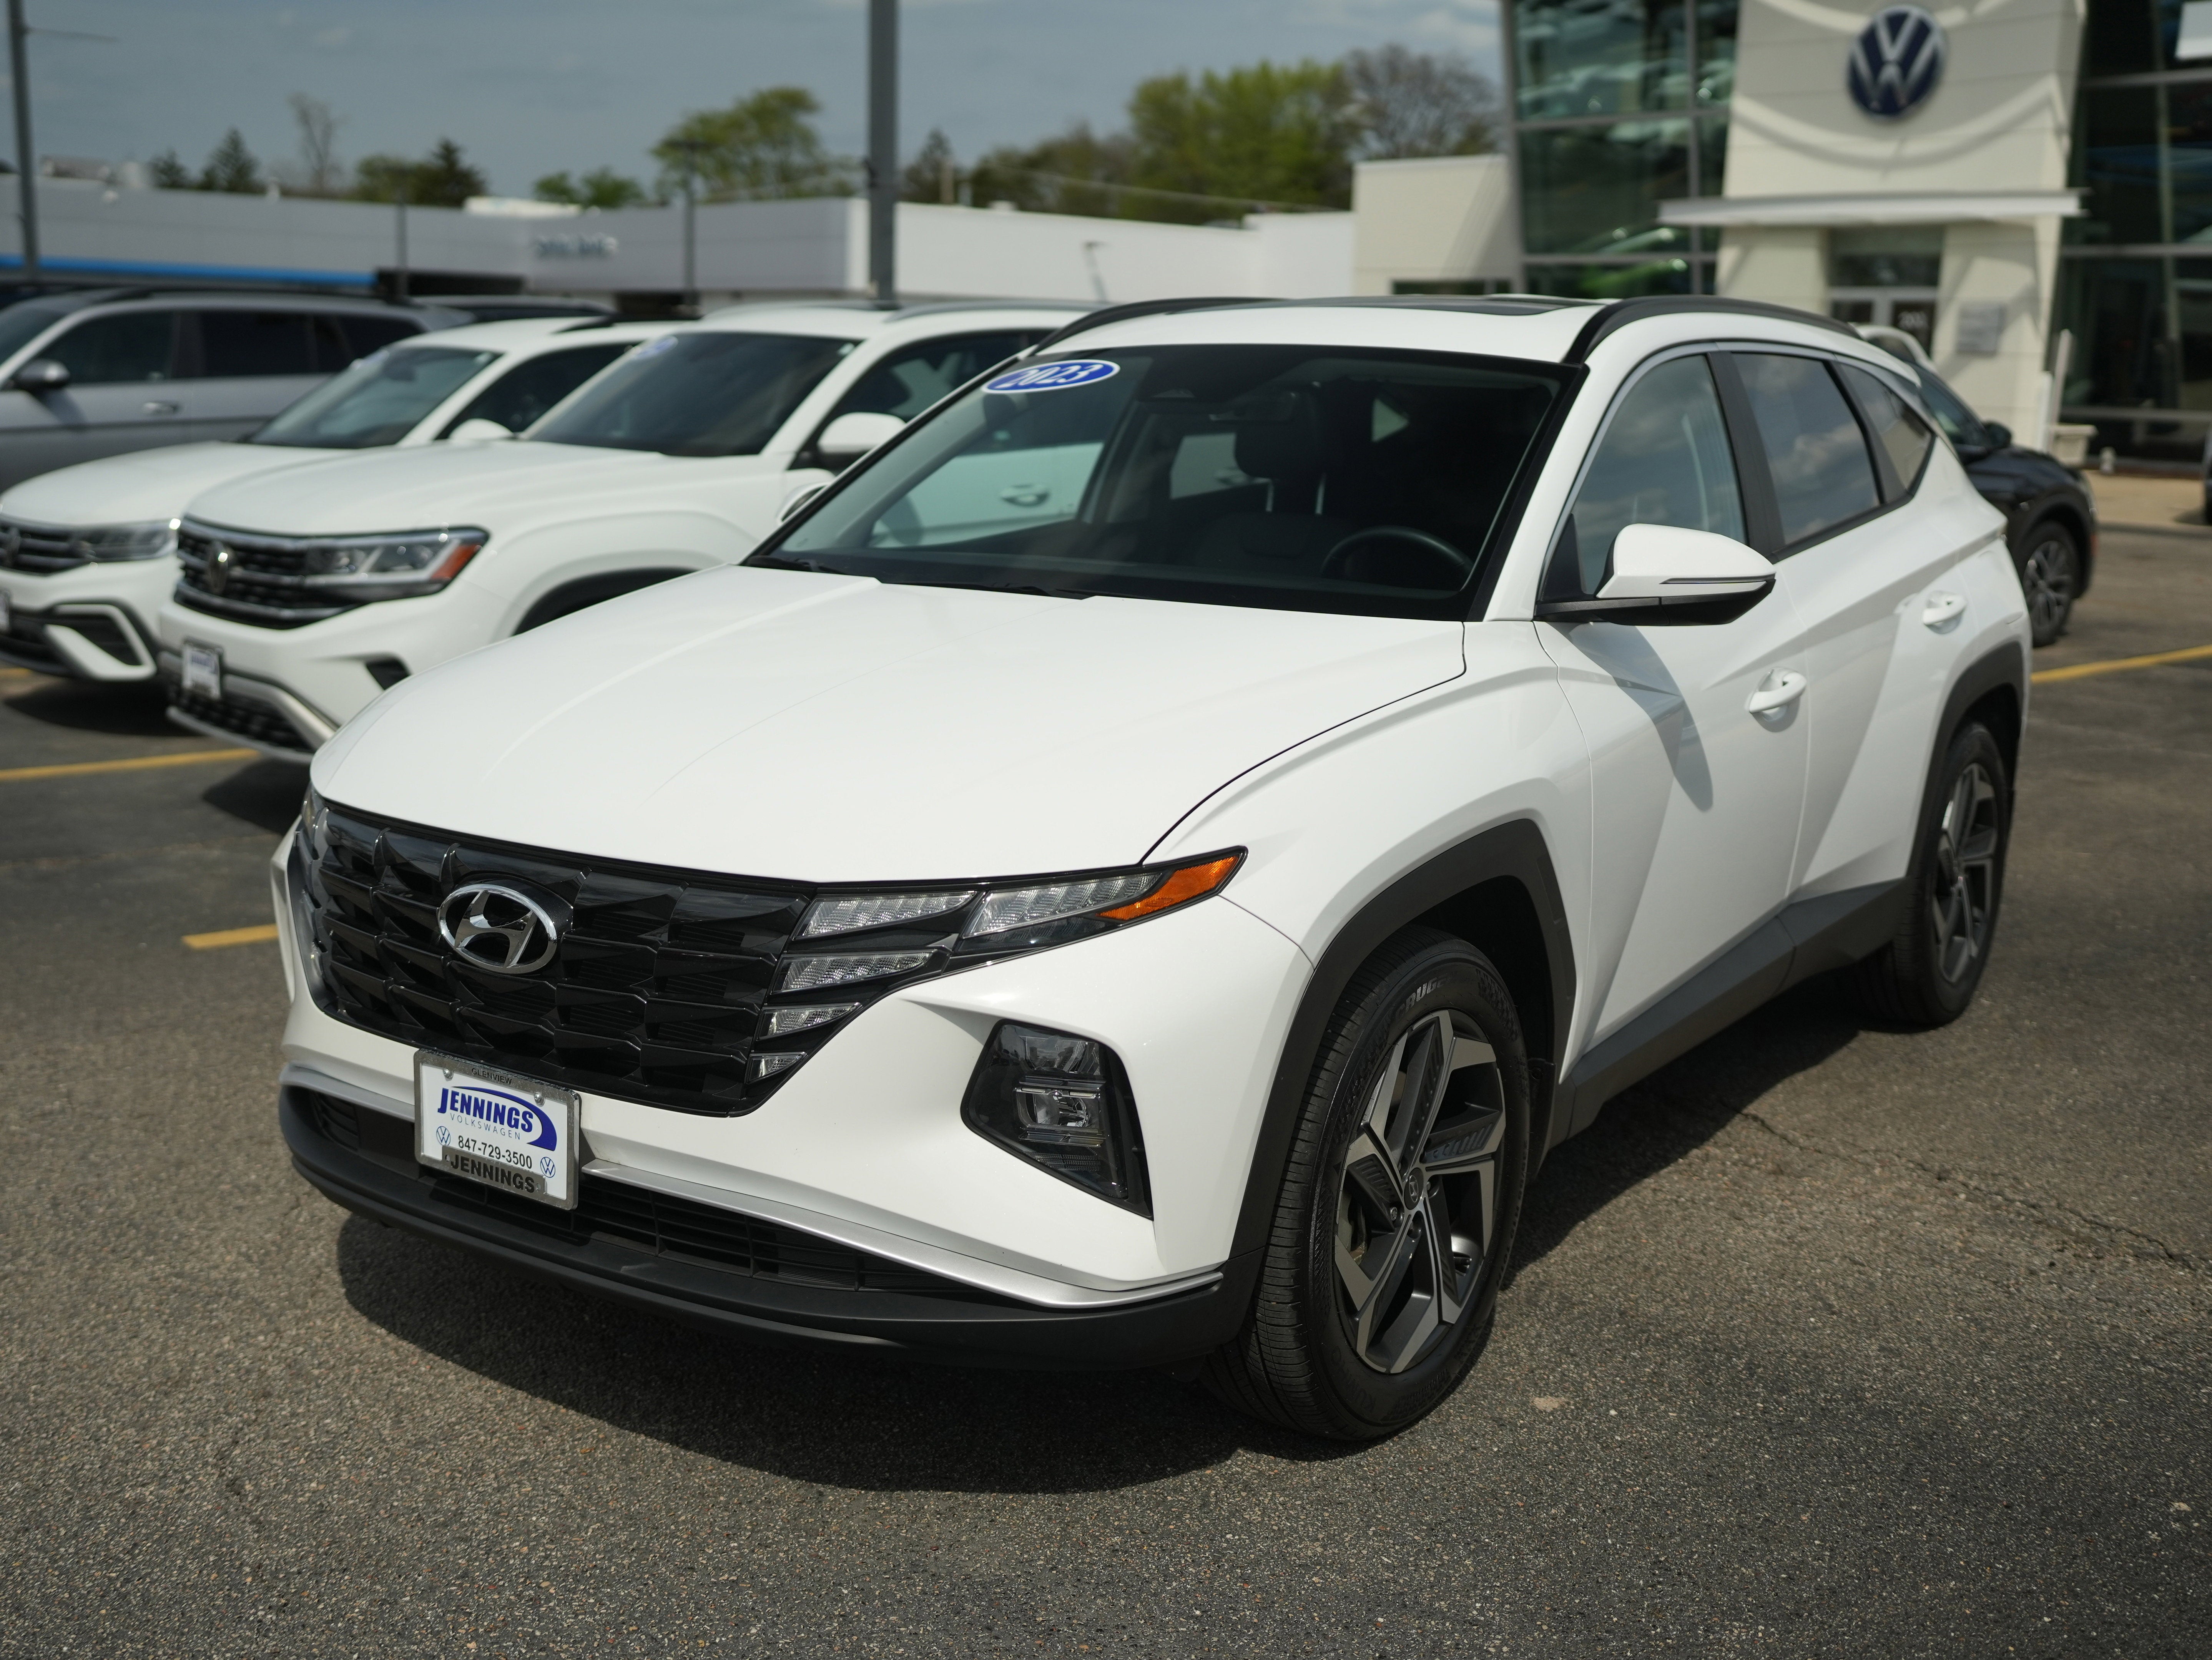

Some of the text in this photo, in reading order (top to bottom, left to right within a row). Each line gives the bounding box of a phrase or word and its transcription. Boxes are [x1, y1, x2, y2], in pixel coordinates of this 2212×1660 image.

[994, 364, 1104, 390] 2023
[471, 1067, 512, 1084] GLENVIEW
[437, 1087, 533, 1133] JENNINGS
[450, 1113, 520, 1140] VOLKSWAGEN
[458, 1135, 532, 1169] 847-729-3500
[450, 1154, 535, 1193] JENNINGS
